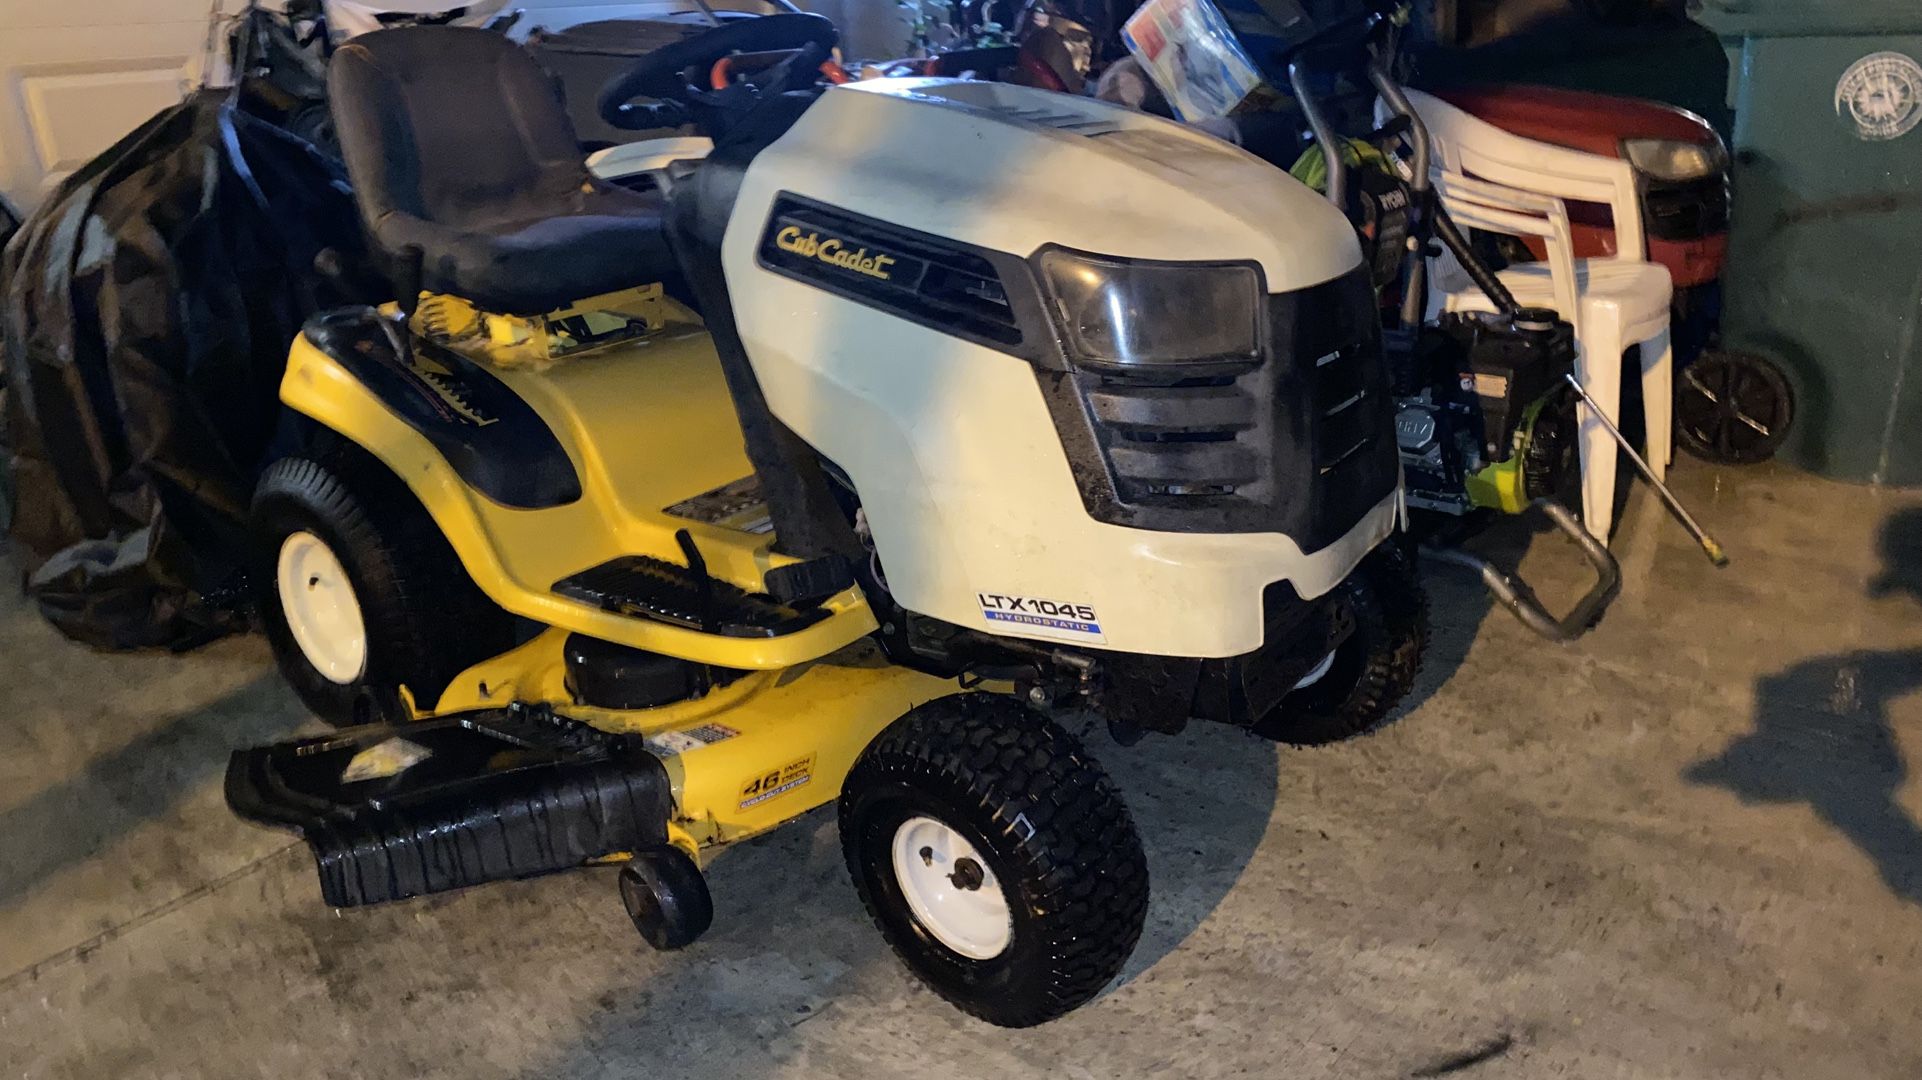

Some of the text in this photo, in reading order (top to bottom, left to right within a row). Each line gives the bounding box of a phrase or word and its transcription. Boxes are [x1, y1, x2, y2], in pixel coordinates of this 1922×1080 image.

[994, 612, 1090, 631] HYDROSTATIC
[784, 757, 811, 774] INCH
[743, 769, 781, 796] 46
[781, 766, 809, 784] DECK
